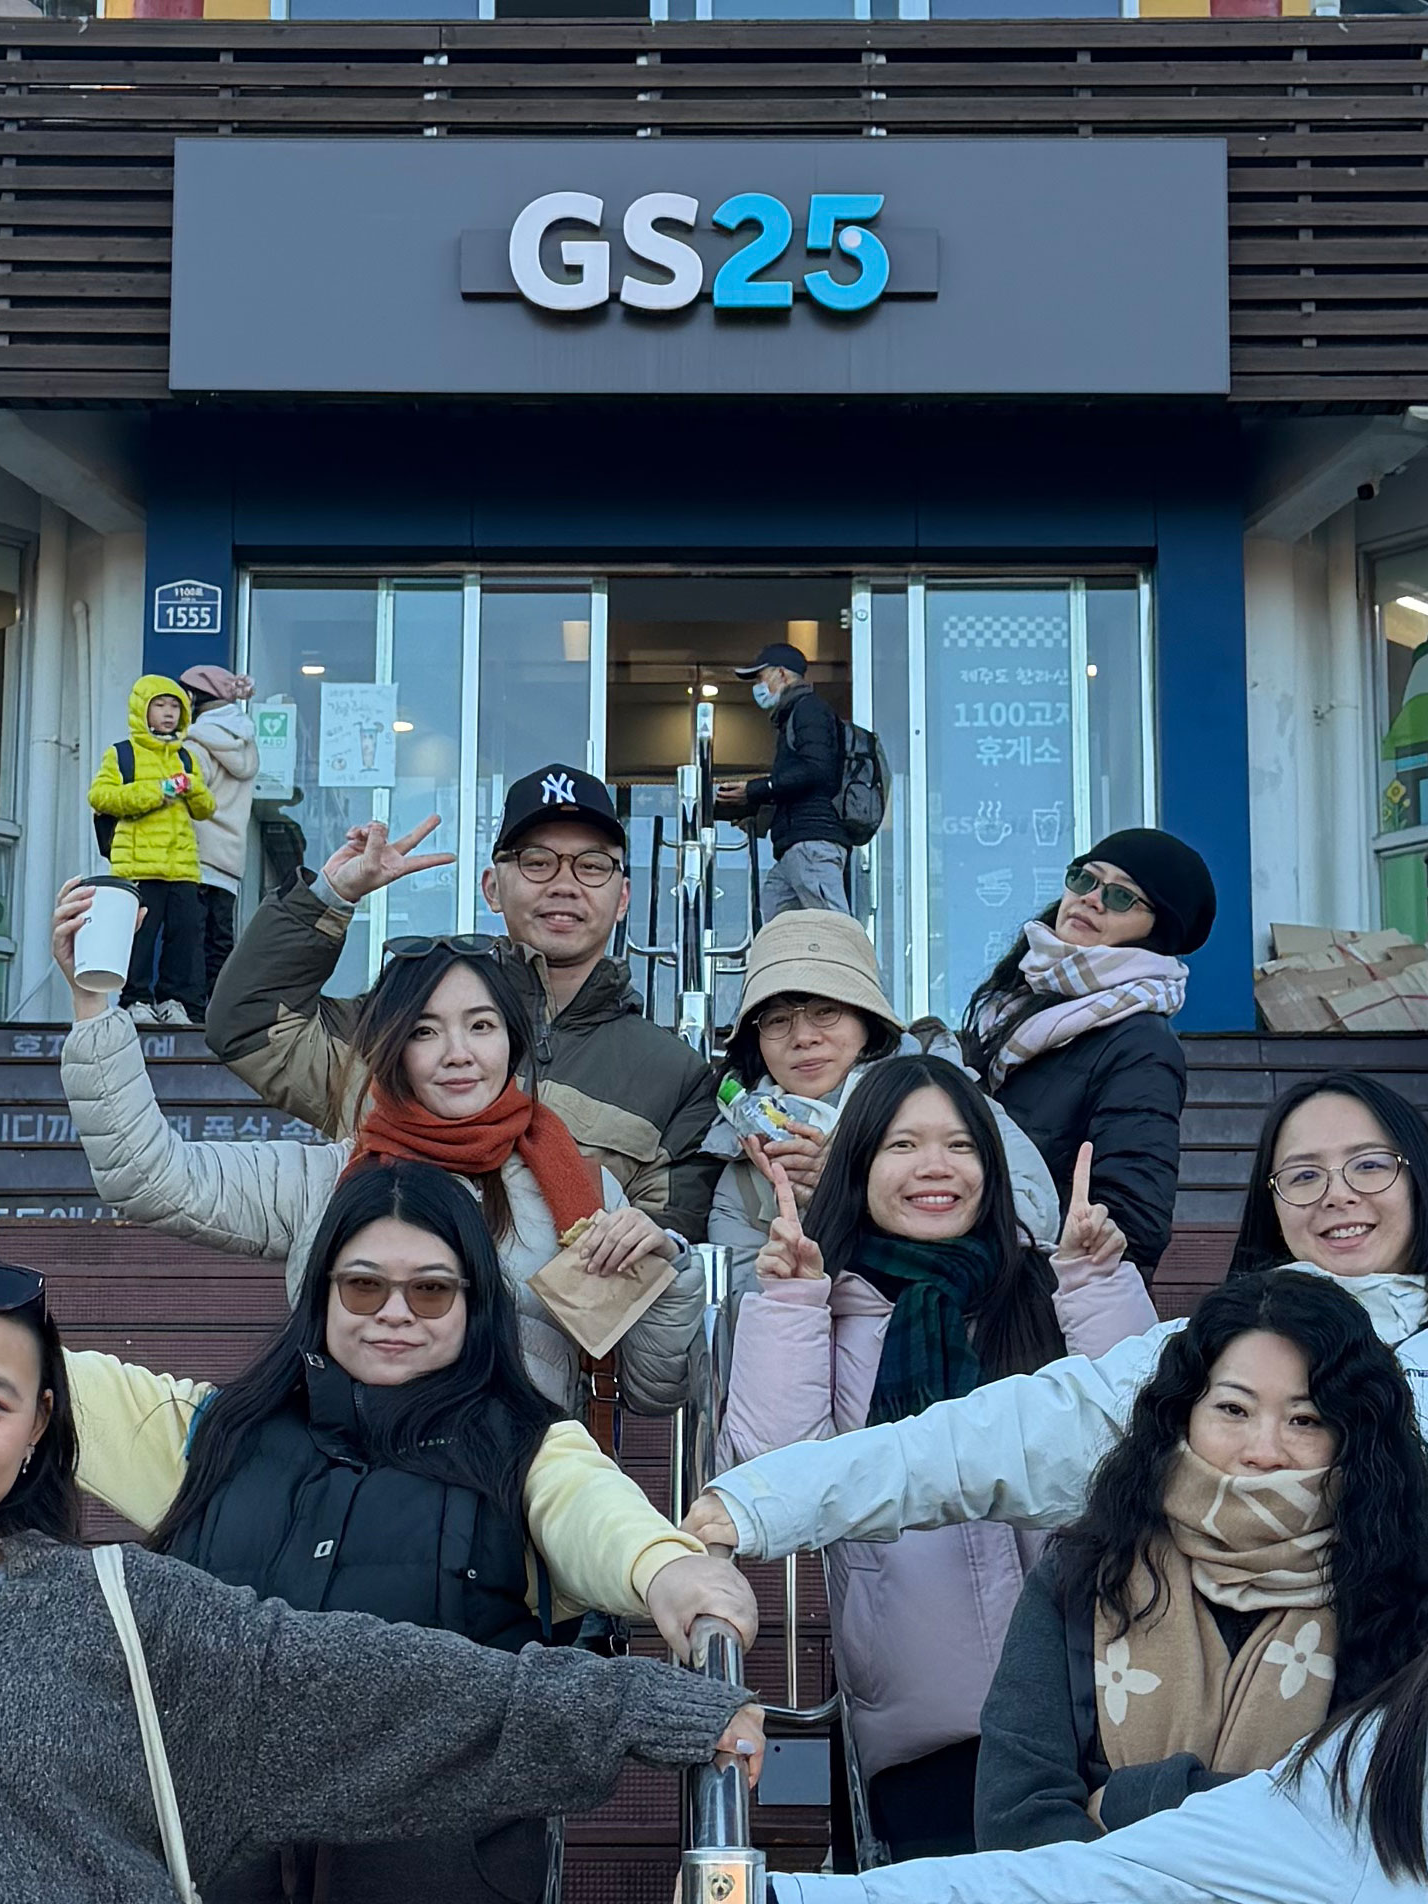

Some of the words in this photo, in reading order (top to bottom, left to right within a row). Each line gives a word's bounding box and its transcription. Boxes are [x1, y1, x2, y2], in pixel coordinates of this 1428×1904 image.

[509, 191, 890, 312] GS25
[166, 606, 211, 627] 1555
[959, 667, 1010, 685] 제주도
[976, 735, 1061, 765] 휴게소
